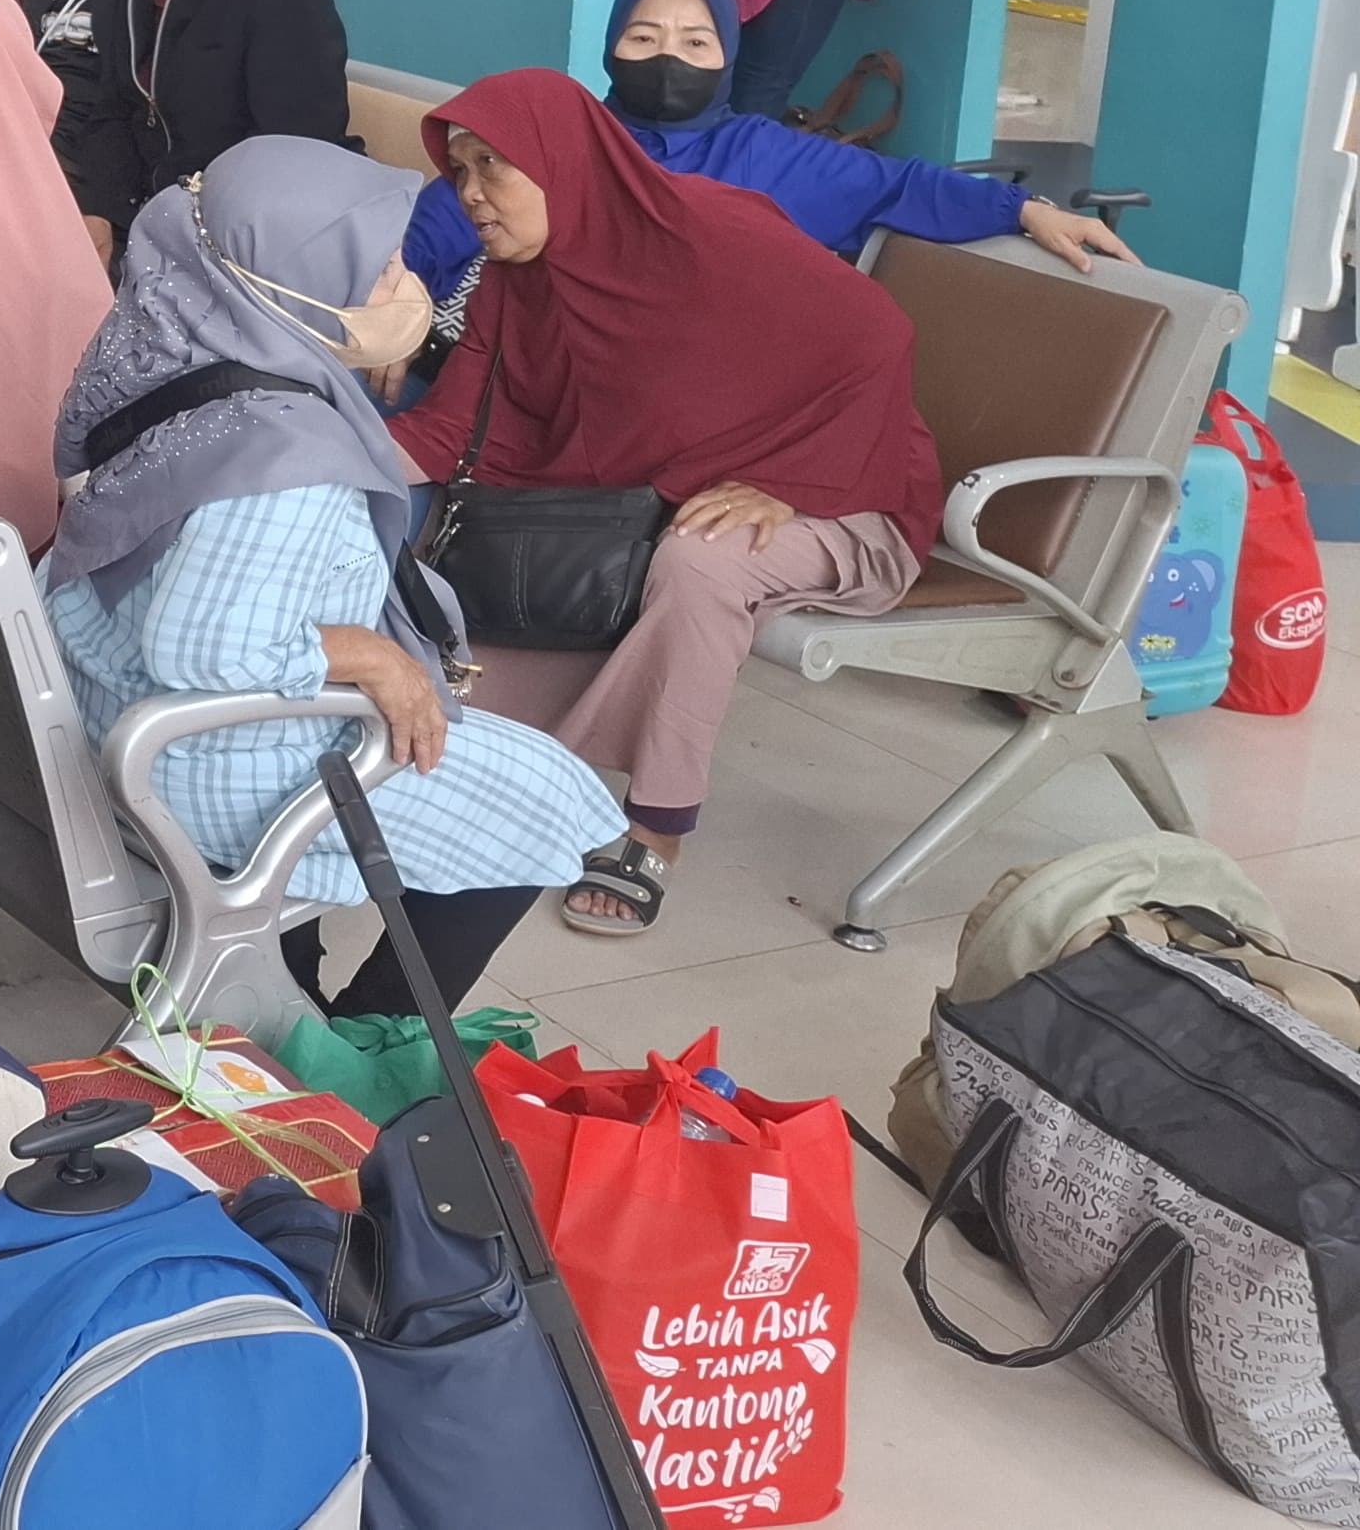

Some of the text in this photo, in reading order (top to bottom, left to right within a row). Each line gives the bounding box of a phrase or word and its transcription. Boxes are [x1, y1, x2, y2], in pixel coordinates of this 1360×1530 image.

[1280, 596, 1323, 626] SGM
[641, 1292, 832, 1352] Lebih Asik
[696, 1347, 784, 1381] TANPA
[638, 1380, 808, 1434] Kantong
